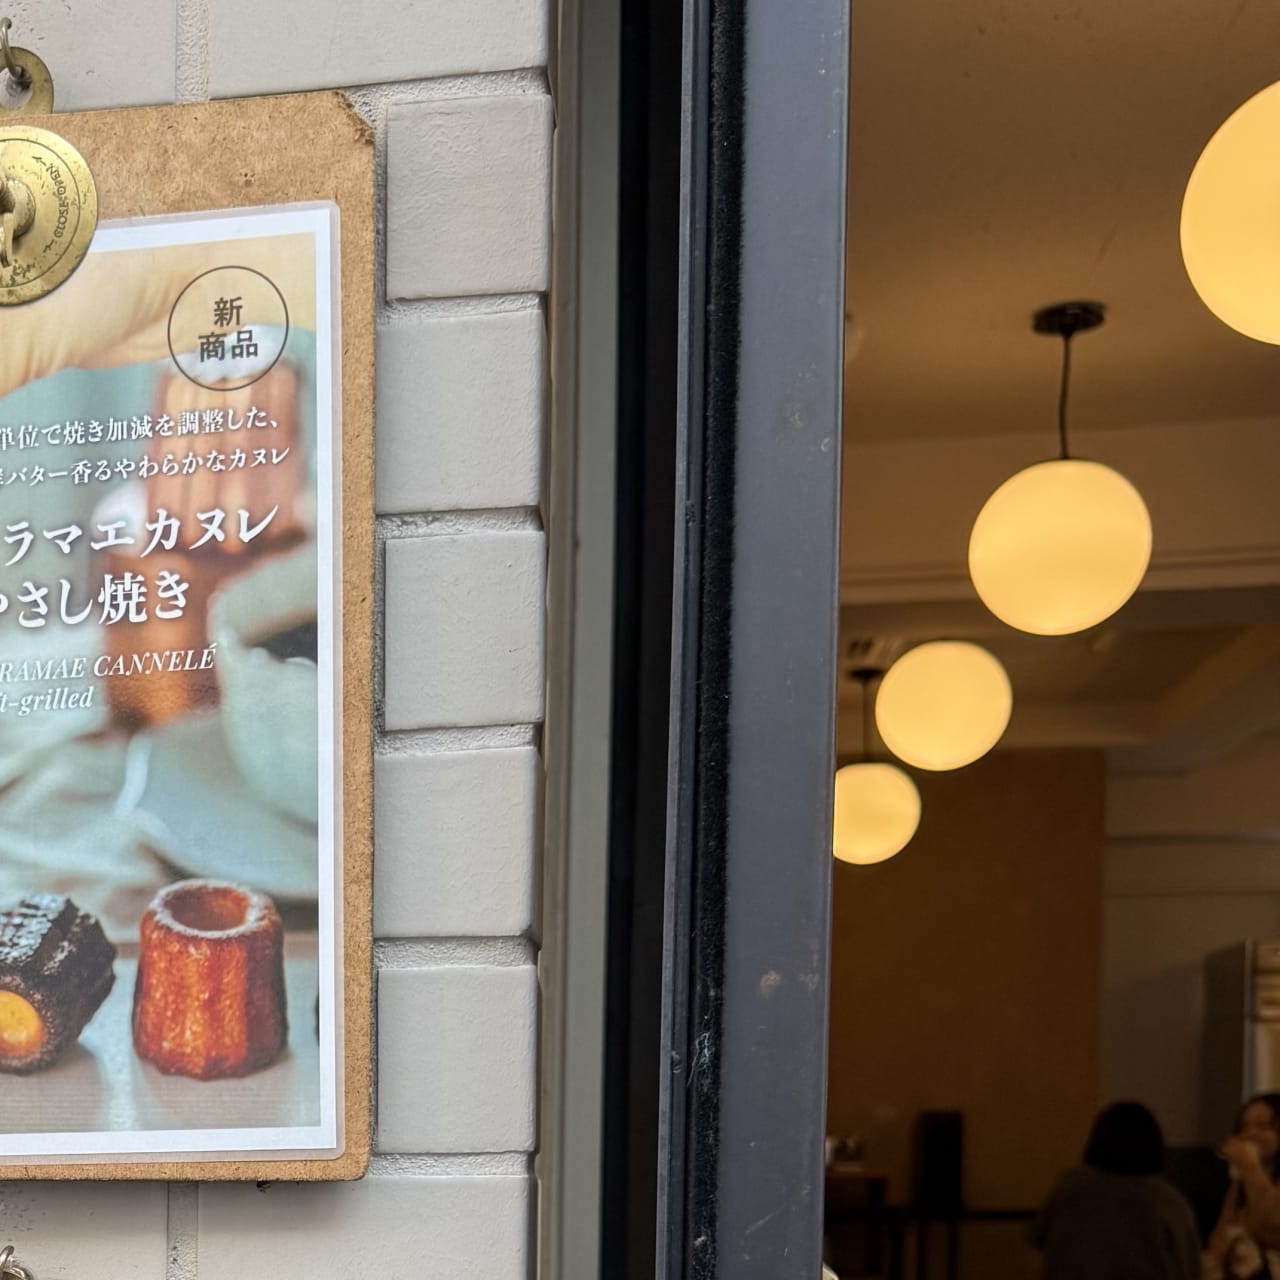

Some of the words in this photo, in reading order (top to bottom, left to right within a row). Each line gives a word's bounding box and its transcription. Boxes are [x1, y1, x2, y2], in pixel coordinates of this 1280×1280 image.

[213, 296, 243, 328] 新
[198, 329, 258, 363] 商品
[93, 642, 218, 677] CANNELÉ
